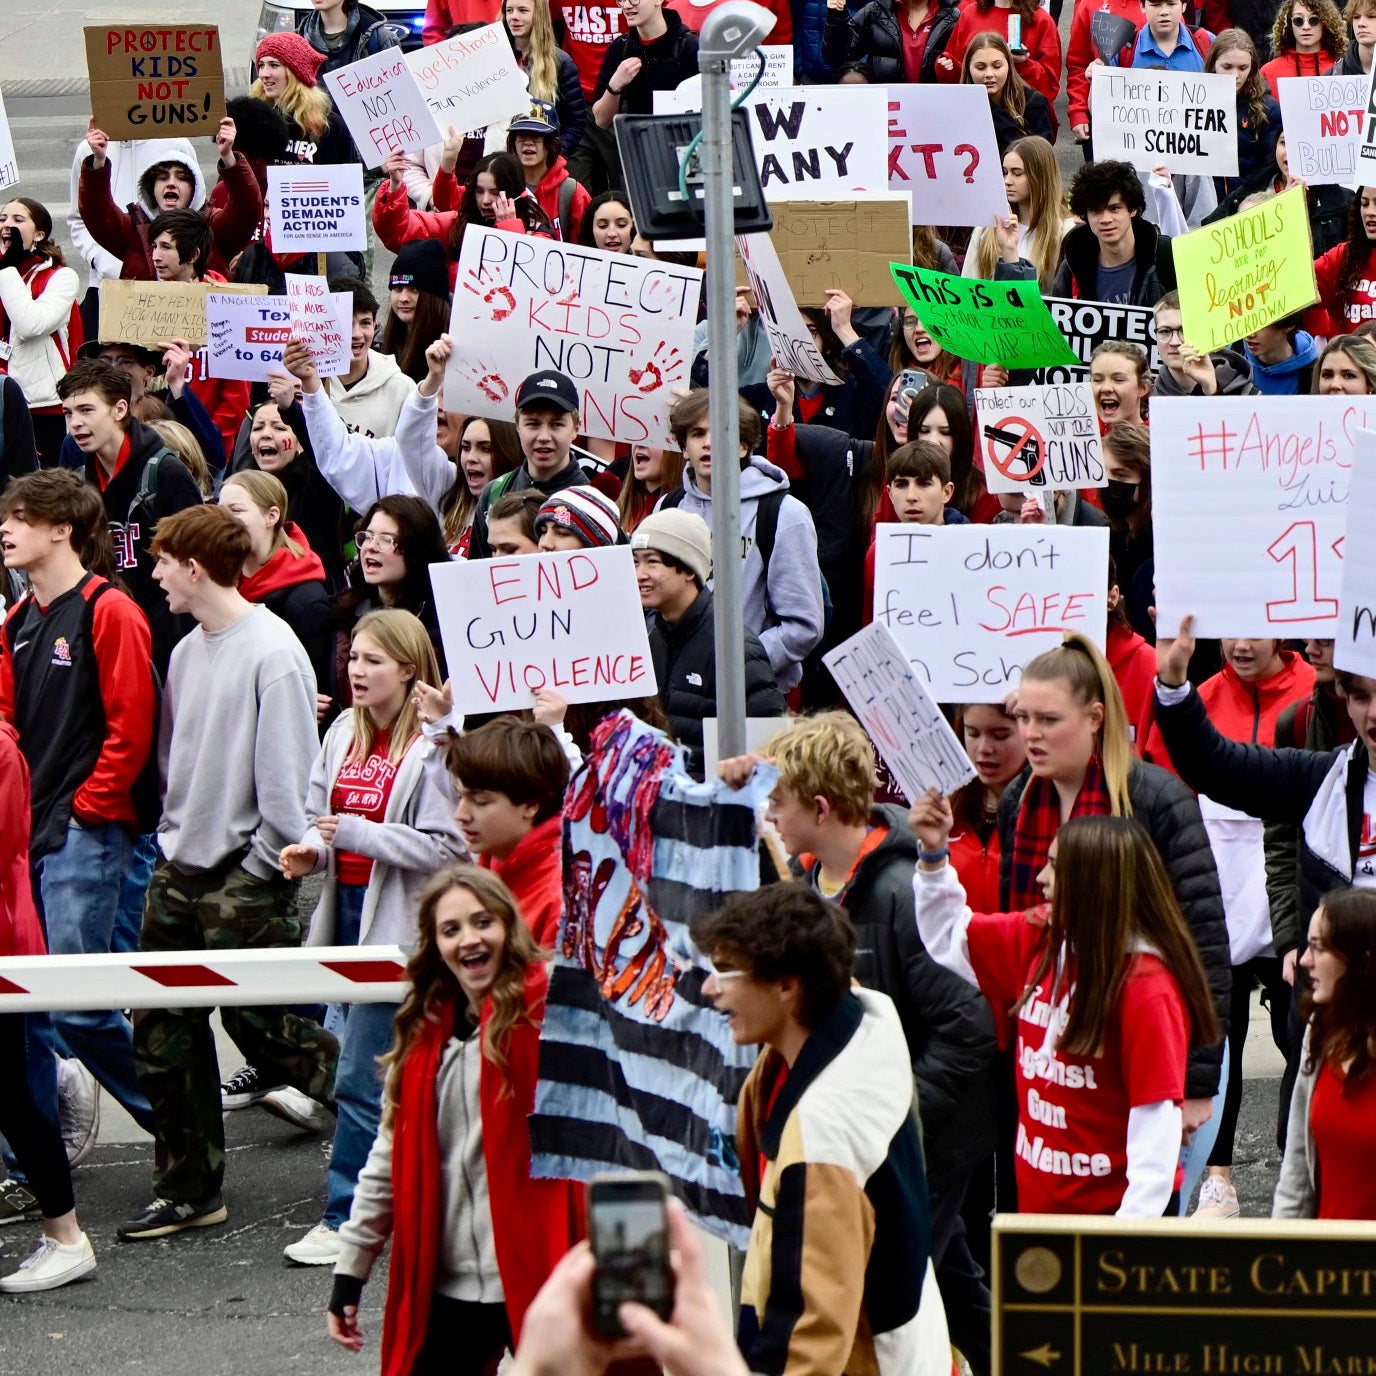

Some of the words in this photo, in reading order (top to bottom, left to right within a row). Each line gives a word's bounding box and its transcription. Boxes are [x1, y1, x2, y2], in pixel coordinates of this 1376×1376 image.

[562, 6, 622, 35] EAST
[130, 54, 198, 79] KIDS
[138, 80, 189, 101] NOT
[362, 90, 398, 121] NOT
[1182, 82, 1206, 105] NO
[127, 92, 211, 125] GUNS!
[1113, 106, 1150, 124] room
[1185, 108, 1227, 133] FEAR
[370, 116, 420, 155] FEAR
[1145, 129, 1208, 156] SCHOOL
[281, 196, 360, 208] STUDENTS
[282, 209, 344, 219] DEMAND
[283, 221, 337, 231] ACTION
[1210, 203, 1283, 264] SCHOOLS
[478, 233, 702, 322] PROTECT
[1229, 283, 1269, 319] NOT
[530, 297, 641, 345] KIDS
[1212, 296, 1286, 347] LOCKDOWN
[236, 348, 248, 360] to
[534, 334, 625, 383] NOT
[976, 390, 1015, 410] Protect
[1019, 396, 1036, 408] our
[1043, 386, 1088, 415] KIDS
[1048, 422, 1066, 436] NOT
[1049, 439, 1103, 482] GUNS
[889, 533, 929, 565] I
[491, 556, 597, 604] END
[879, 589, 957, 633] feel
[468, 610, 571, 648] GUN
[475, 654, 646, 703] VIOLENCE
